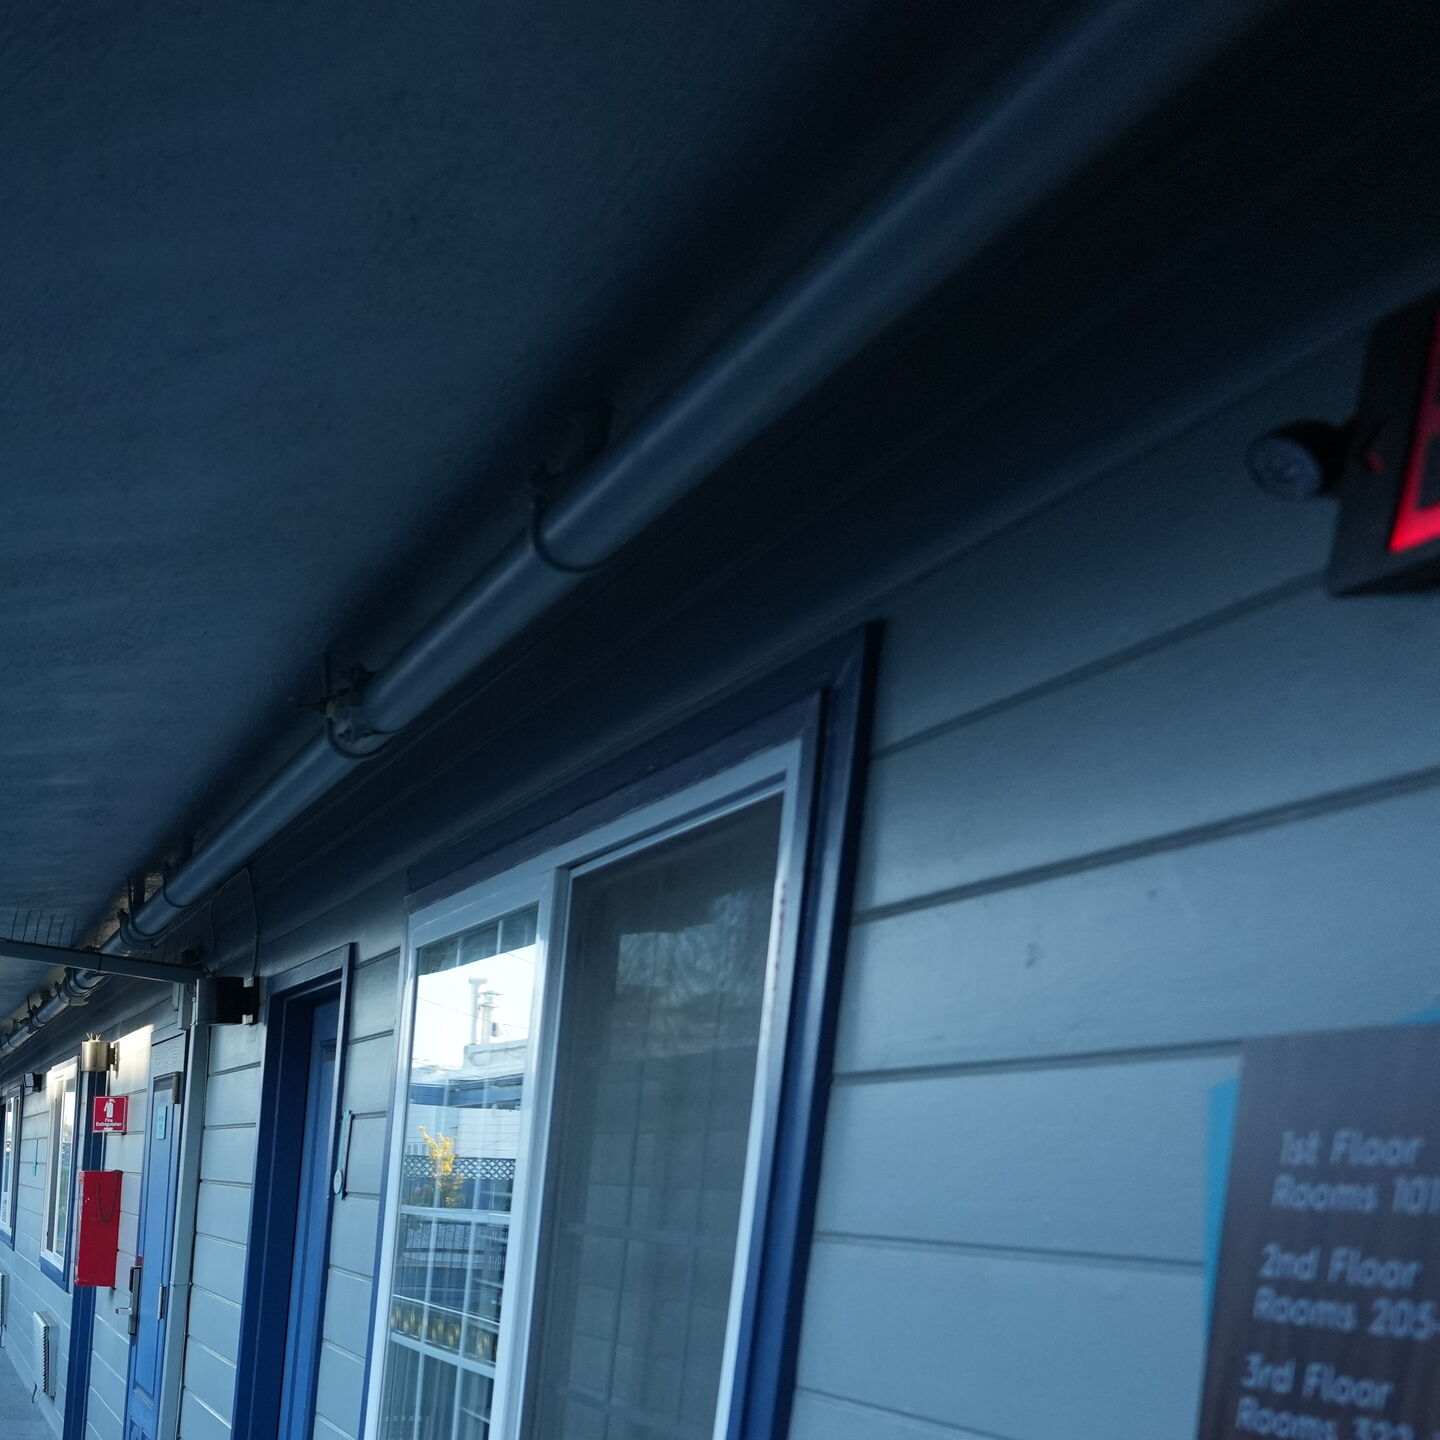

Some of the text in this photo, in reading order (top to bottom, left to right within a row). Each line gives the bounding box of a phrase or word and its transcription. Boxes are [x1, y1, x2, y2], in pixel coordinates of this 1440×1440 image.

[1280, 1127, 1424, 1168] 1st Floor
[1271, 1172, 1379, 1214] Rooms
[1258, 1242, 1424, 1290] 2nd Floor
[1252, 1284, 1359, 1333] Rooms
[1240, 1353, 1395, 1411] 3rd Floor
